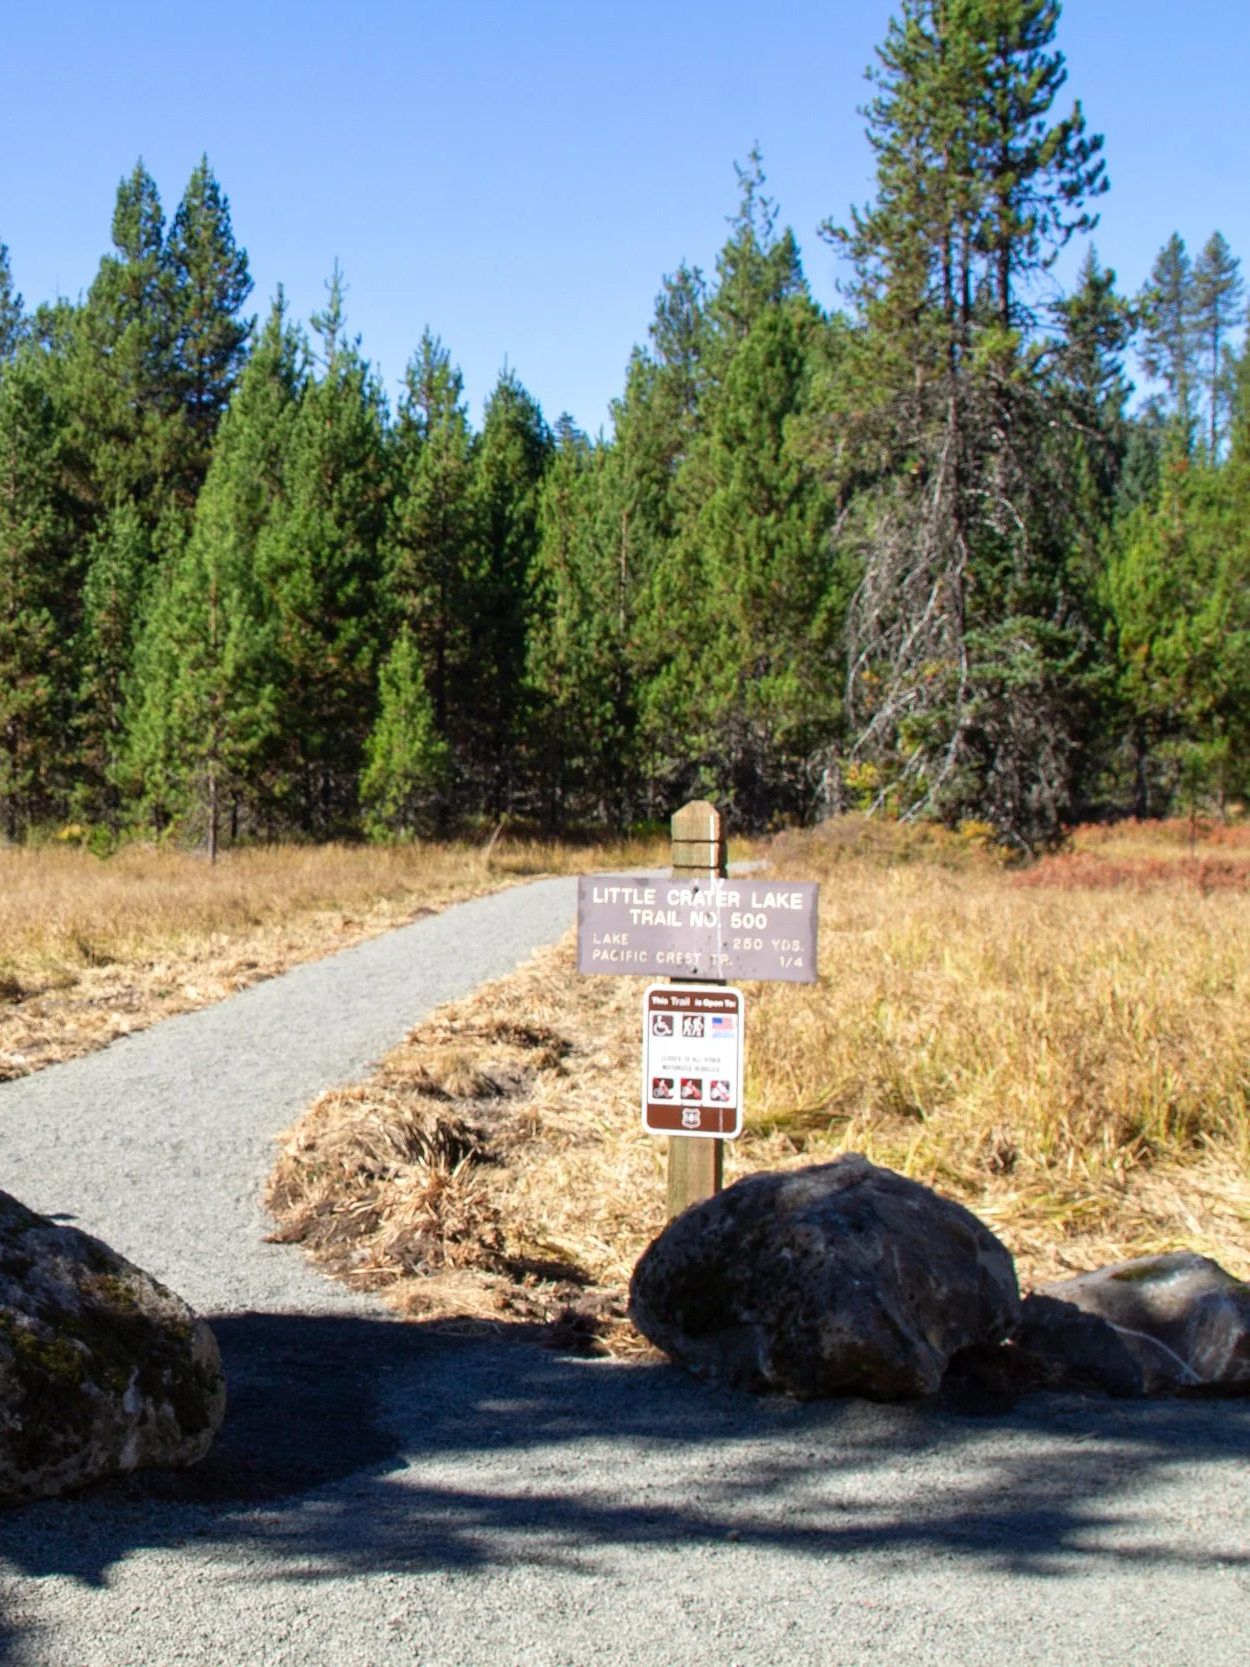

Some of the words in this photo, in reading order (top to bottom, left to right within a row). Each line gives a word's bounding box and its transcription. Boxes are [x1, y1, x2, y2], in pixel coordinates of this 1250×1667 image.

[592, 887, 657, 904] LITTLE
[667, 889, 740, 908] CRATER
[751, 892, 803, 910] LAKE
[630, 909, 682, 927] TRAIL
[690, 911, 722, 928] NO.
[730, 913, 768, 930] 500
[593, 933, 629, 946] LAKE
[771, 939, 805, 952] YDS.
[592, 950, 648, 963] PACIFIC
[656, 951, 702, 965] CREST
[779, 956, 803, 968] 1/4
[651, 996, 669, 1006] This
[670, 996, 691, 1006] Trail
[694, 997, 703, 1007] is
[703, 998, 724, 1008] Open
